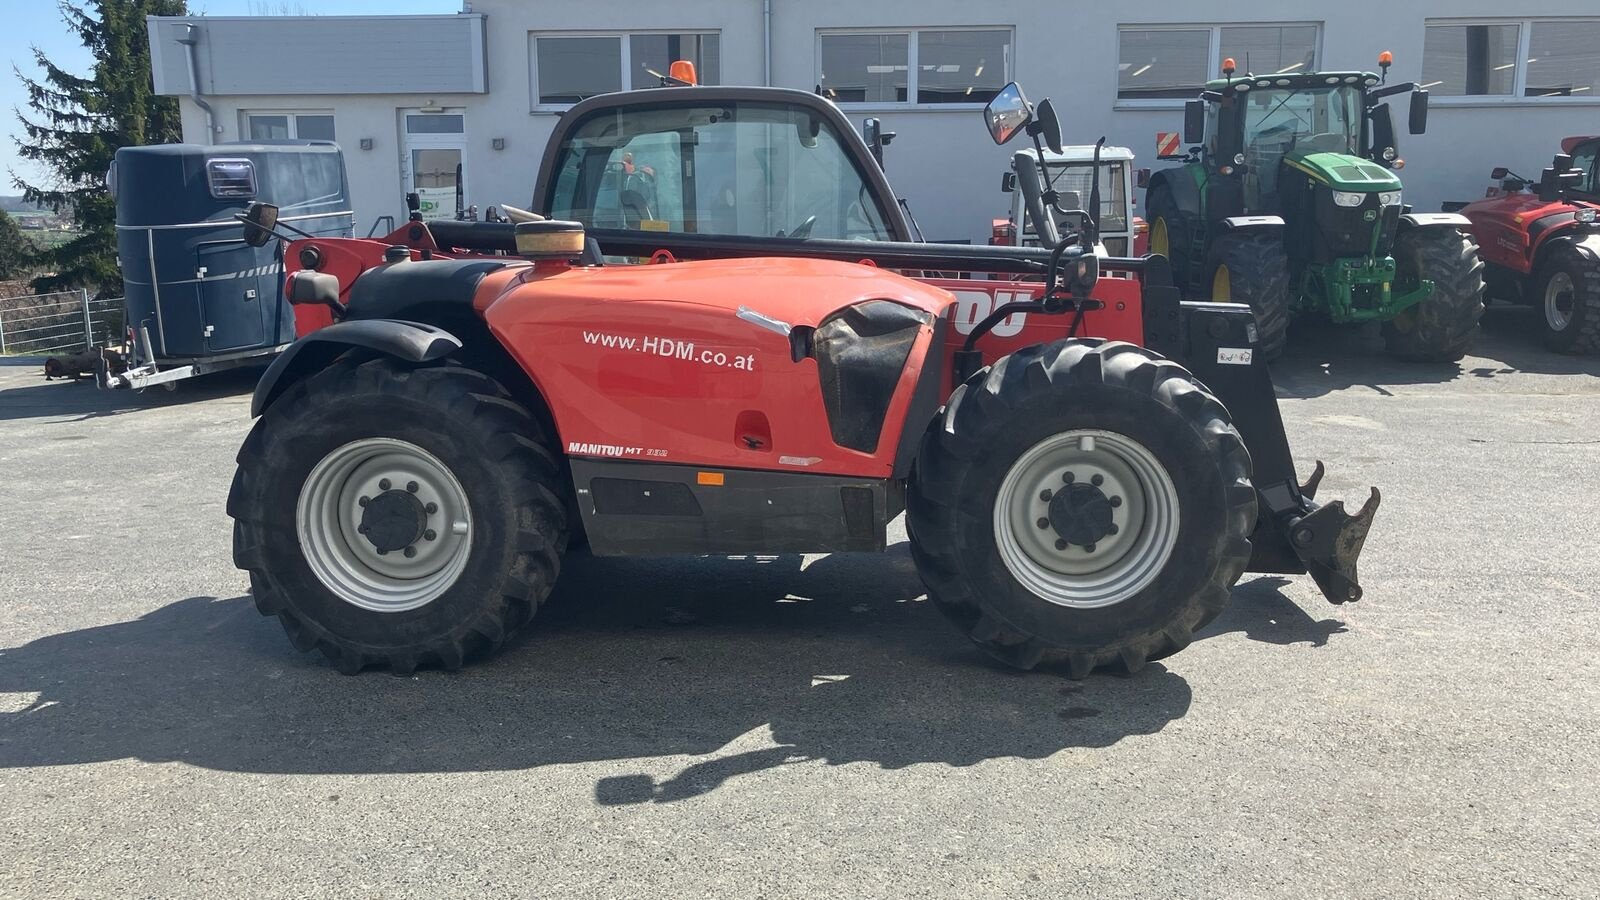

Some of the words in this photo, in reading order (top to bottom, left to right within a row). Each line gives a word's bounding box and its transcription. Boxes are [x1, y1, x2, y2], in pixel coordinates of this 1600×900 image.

[583, 331, 754, 371] www.HDM.co.at
[568, 442, 624, 457] MANITOU
[625, 447, 644, 455] MT
